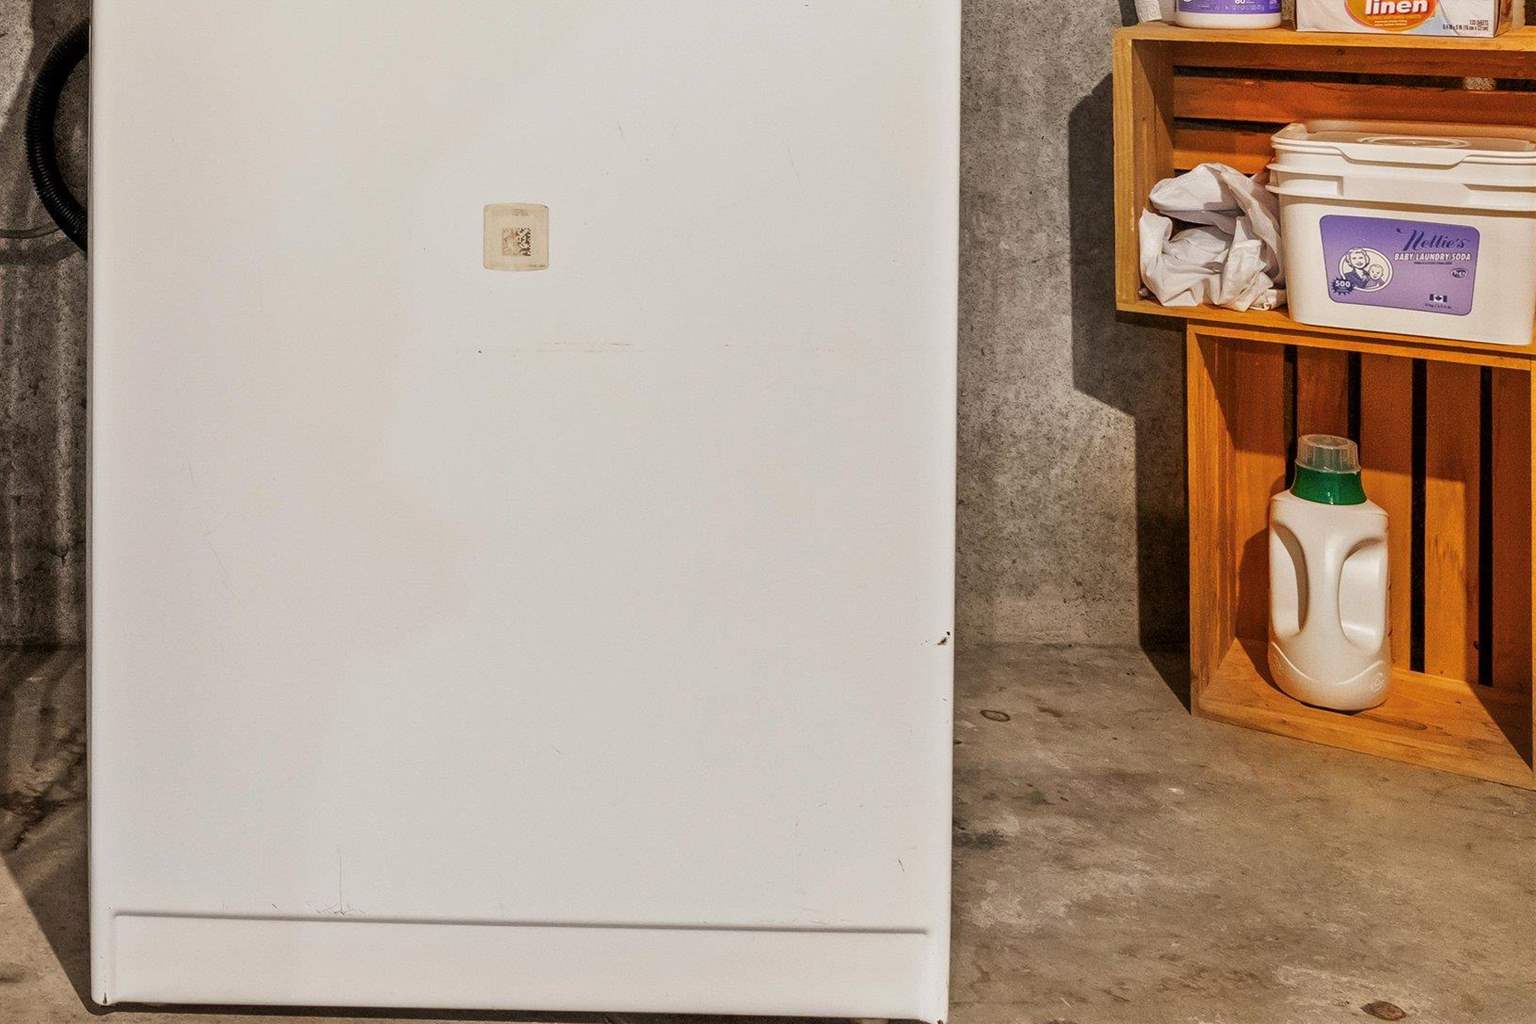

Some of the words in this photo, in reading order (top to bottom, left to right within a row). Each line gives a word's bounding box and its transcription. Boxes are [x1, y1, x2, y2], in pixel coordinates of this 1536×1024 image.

[1396, 228, 1468, 251] Nellie's
[1394, 253, 1413, 261] BABY
[1415, 253, 1450, 261] LAUNDRY
[1451, 253, 1472, 261] SODA
[1335, 280, 1351, 288] 500
